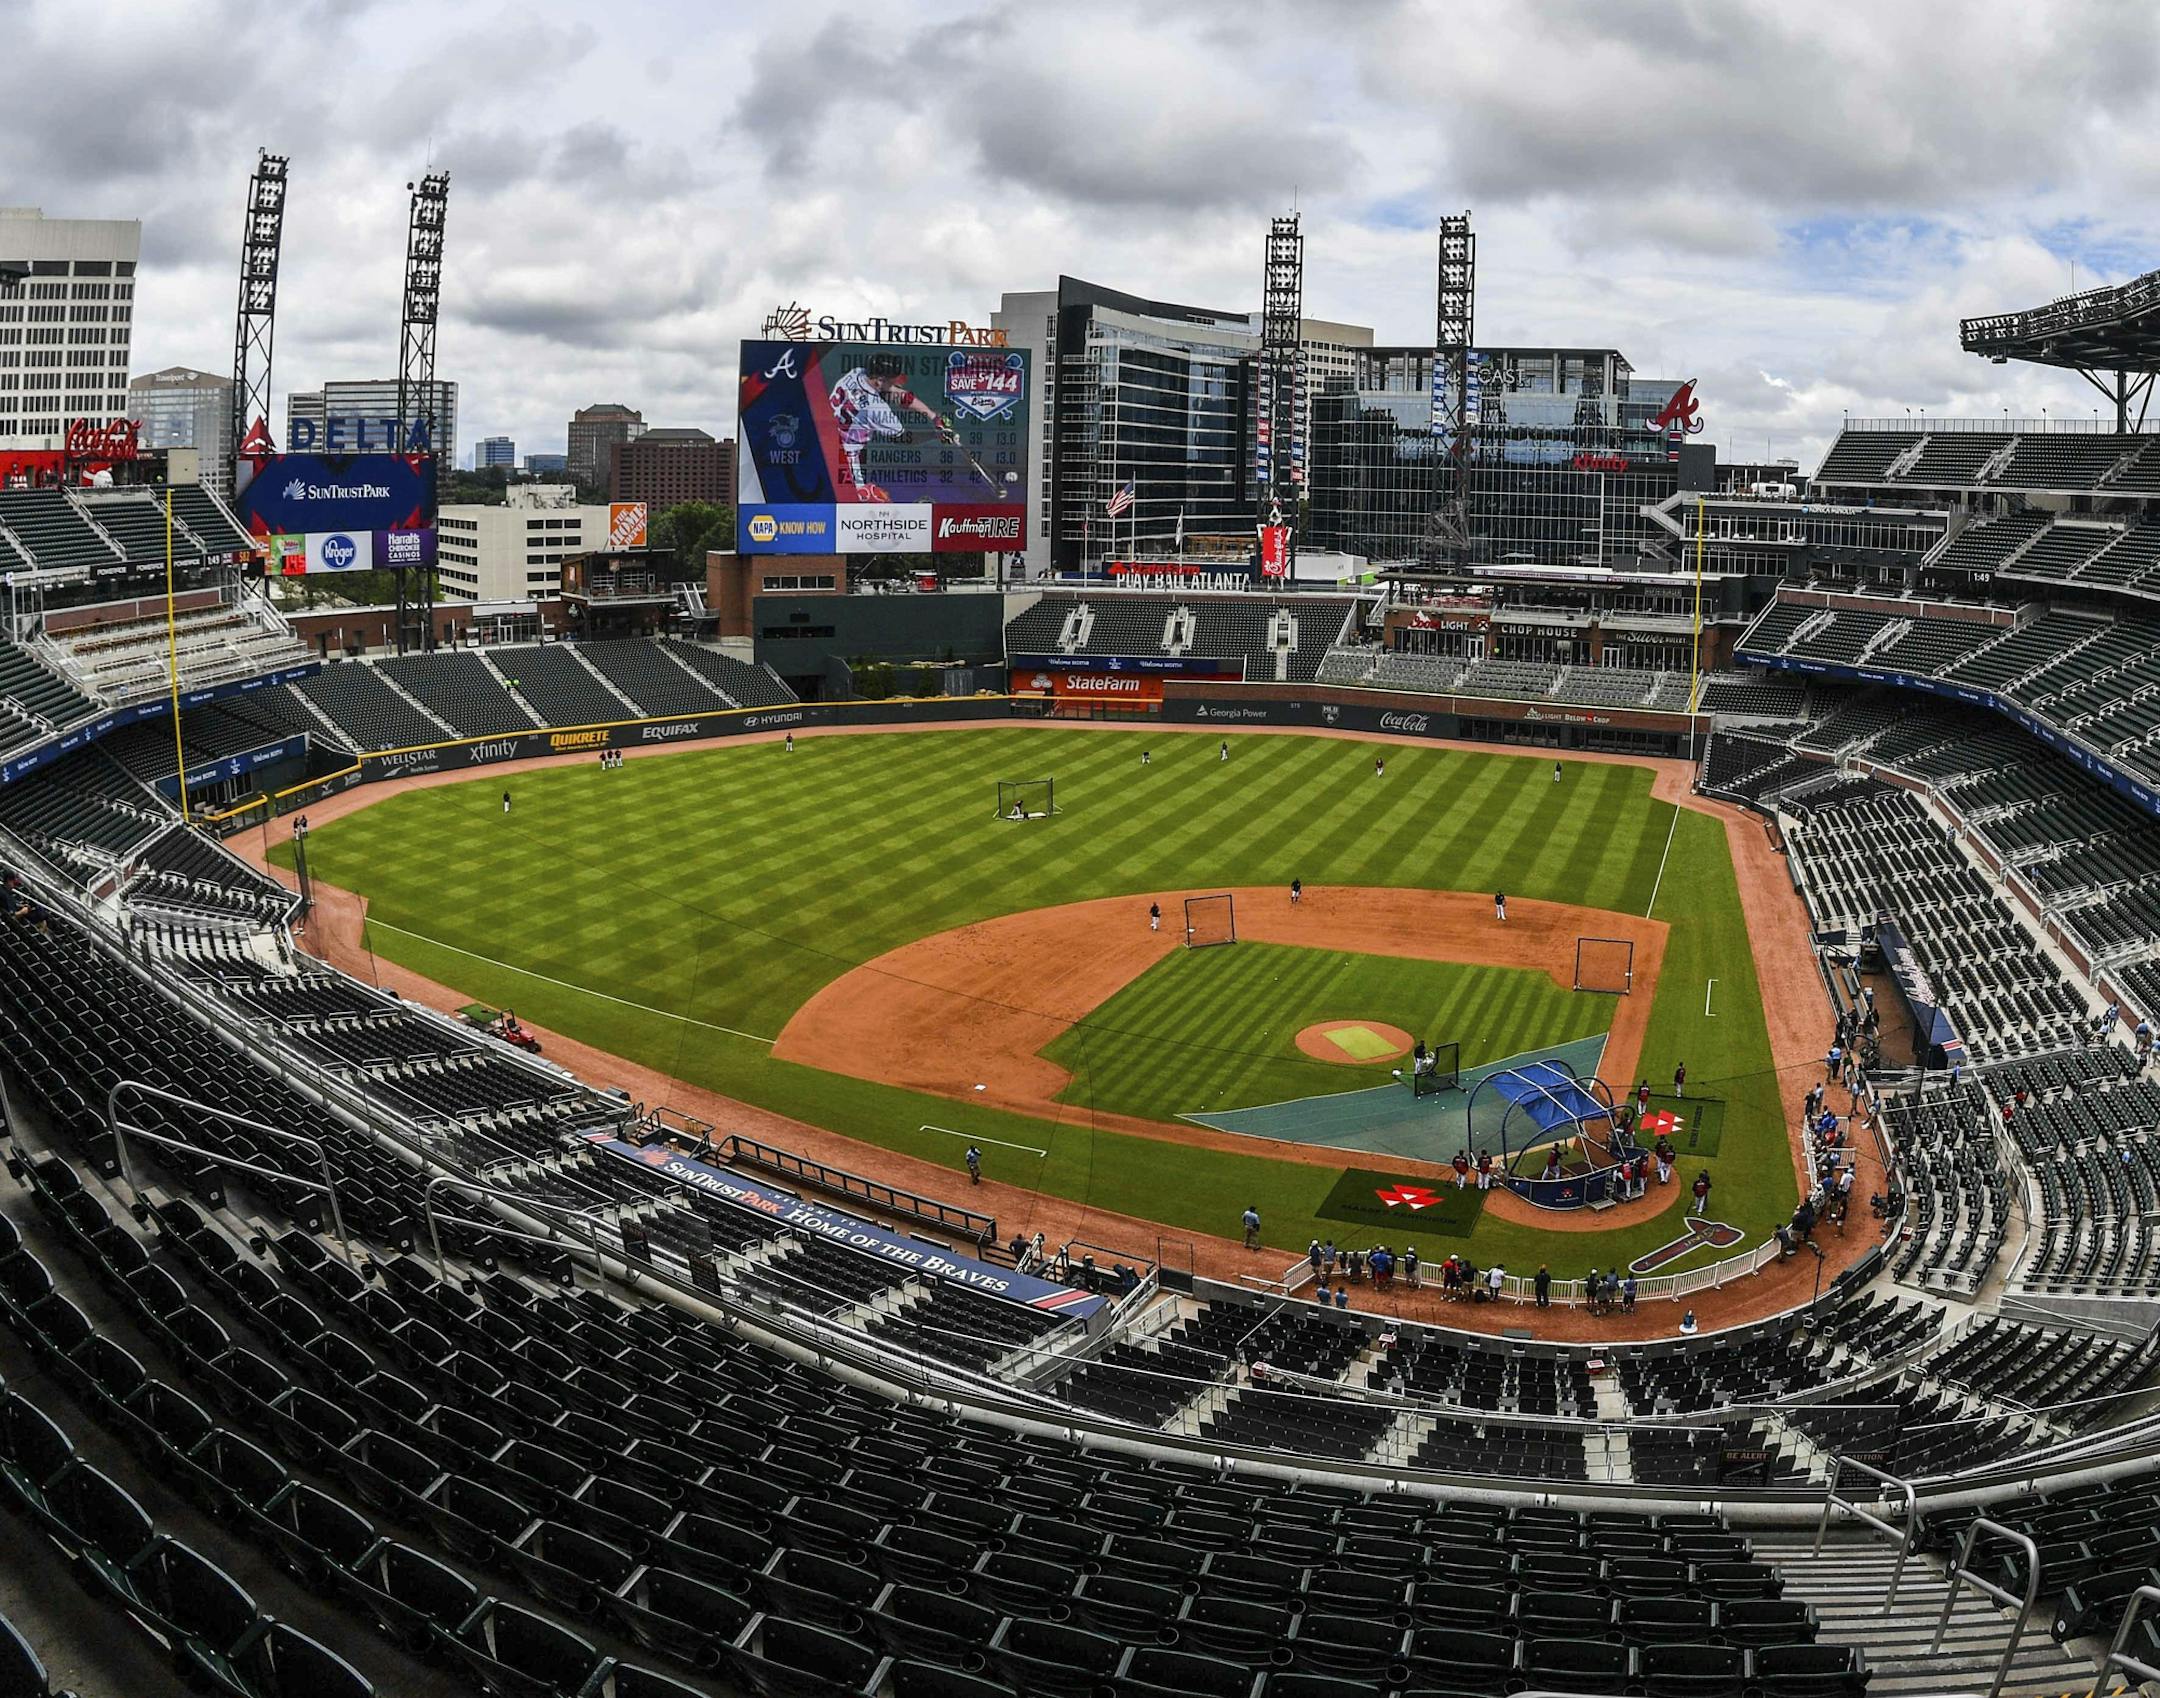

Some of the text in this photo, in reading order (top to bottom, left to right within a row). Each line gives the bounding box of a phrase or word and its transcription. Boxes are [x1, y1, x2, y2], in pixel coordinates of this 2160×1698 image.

[950, 372, 1018, 392] SAVE $144
[291, 418, 432, 450] DELTA
[996, 433, 1016, 445] 13.0
[770, 450, 800, 464] WEST
[870, 451, 921, 464] RANGERS
[940, 451, 954, 464] 36
[996, 452, 1016, 464] 13.0
[870, 470, 928, 484] ATHLETICS
[940, 470, 953, 483] 32
[610, 502, 647, 545] HOME
[753, 520, 826, 535] NAPA KNOW HOW
[841, 519, 928, 531] NORTHSIDE
[938, 516, 1020, 538] Kauffman TIRE
[324, 540, 354, 567] Kroger
[388, 551, 421, 559] CASINOS
[1116, 572, 1250, 590] PLAY BALL ATLANTA
[1974, 572, 1990, 582] 1:49
[1441, 620, 1470, 631] LIGHT
[1501, 625, 1578, 638] CHOP HOUSE
[1627, 631, 1665, 644] Silver
[761, 712, 802, 725] HYUNDAI
[1209, 708, 1267, 719] Georgia Power
[642, 722, 699, 740] EQUIFAX
[550, 730, 610, 747] QUIKRETE
[381, 749, 437, 766] WELLSTAR
[470, 739, 518, 763] xfinity
[773, 1193, 857, 1227] WELCOME TO
[784, 1208, 1010, 1292] HOME OF THE BRAVES
[1726, 1452, 1741, 1460] BE
[1741, 1452, 1769, 1460] ALERT
